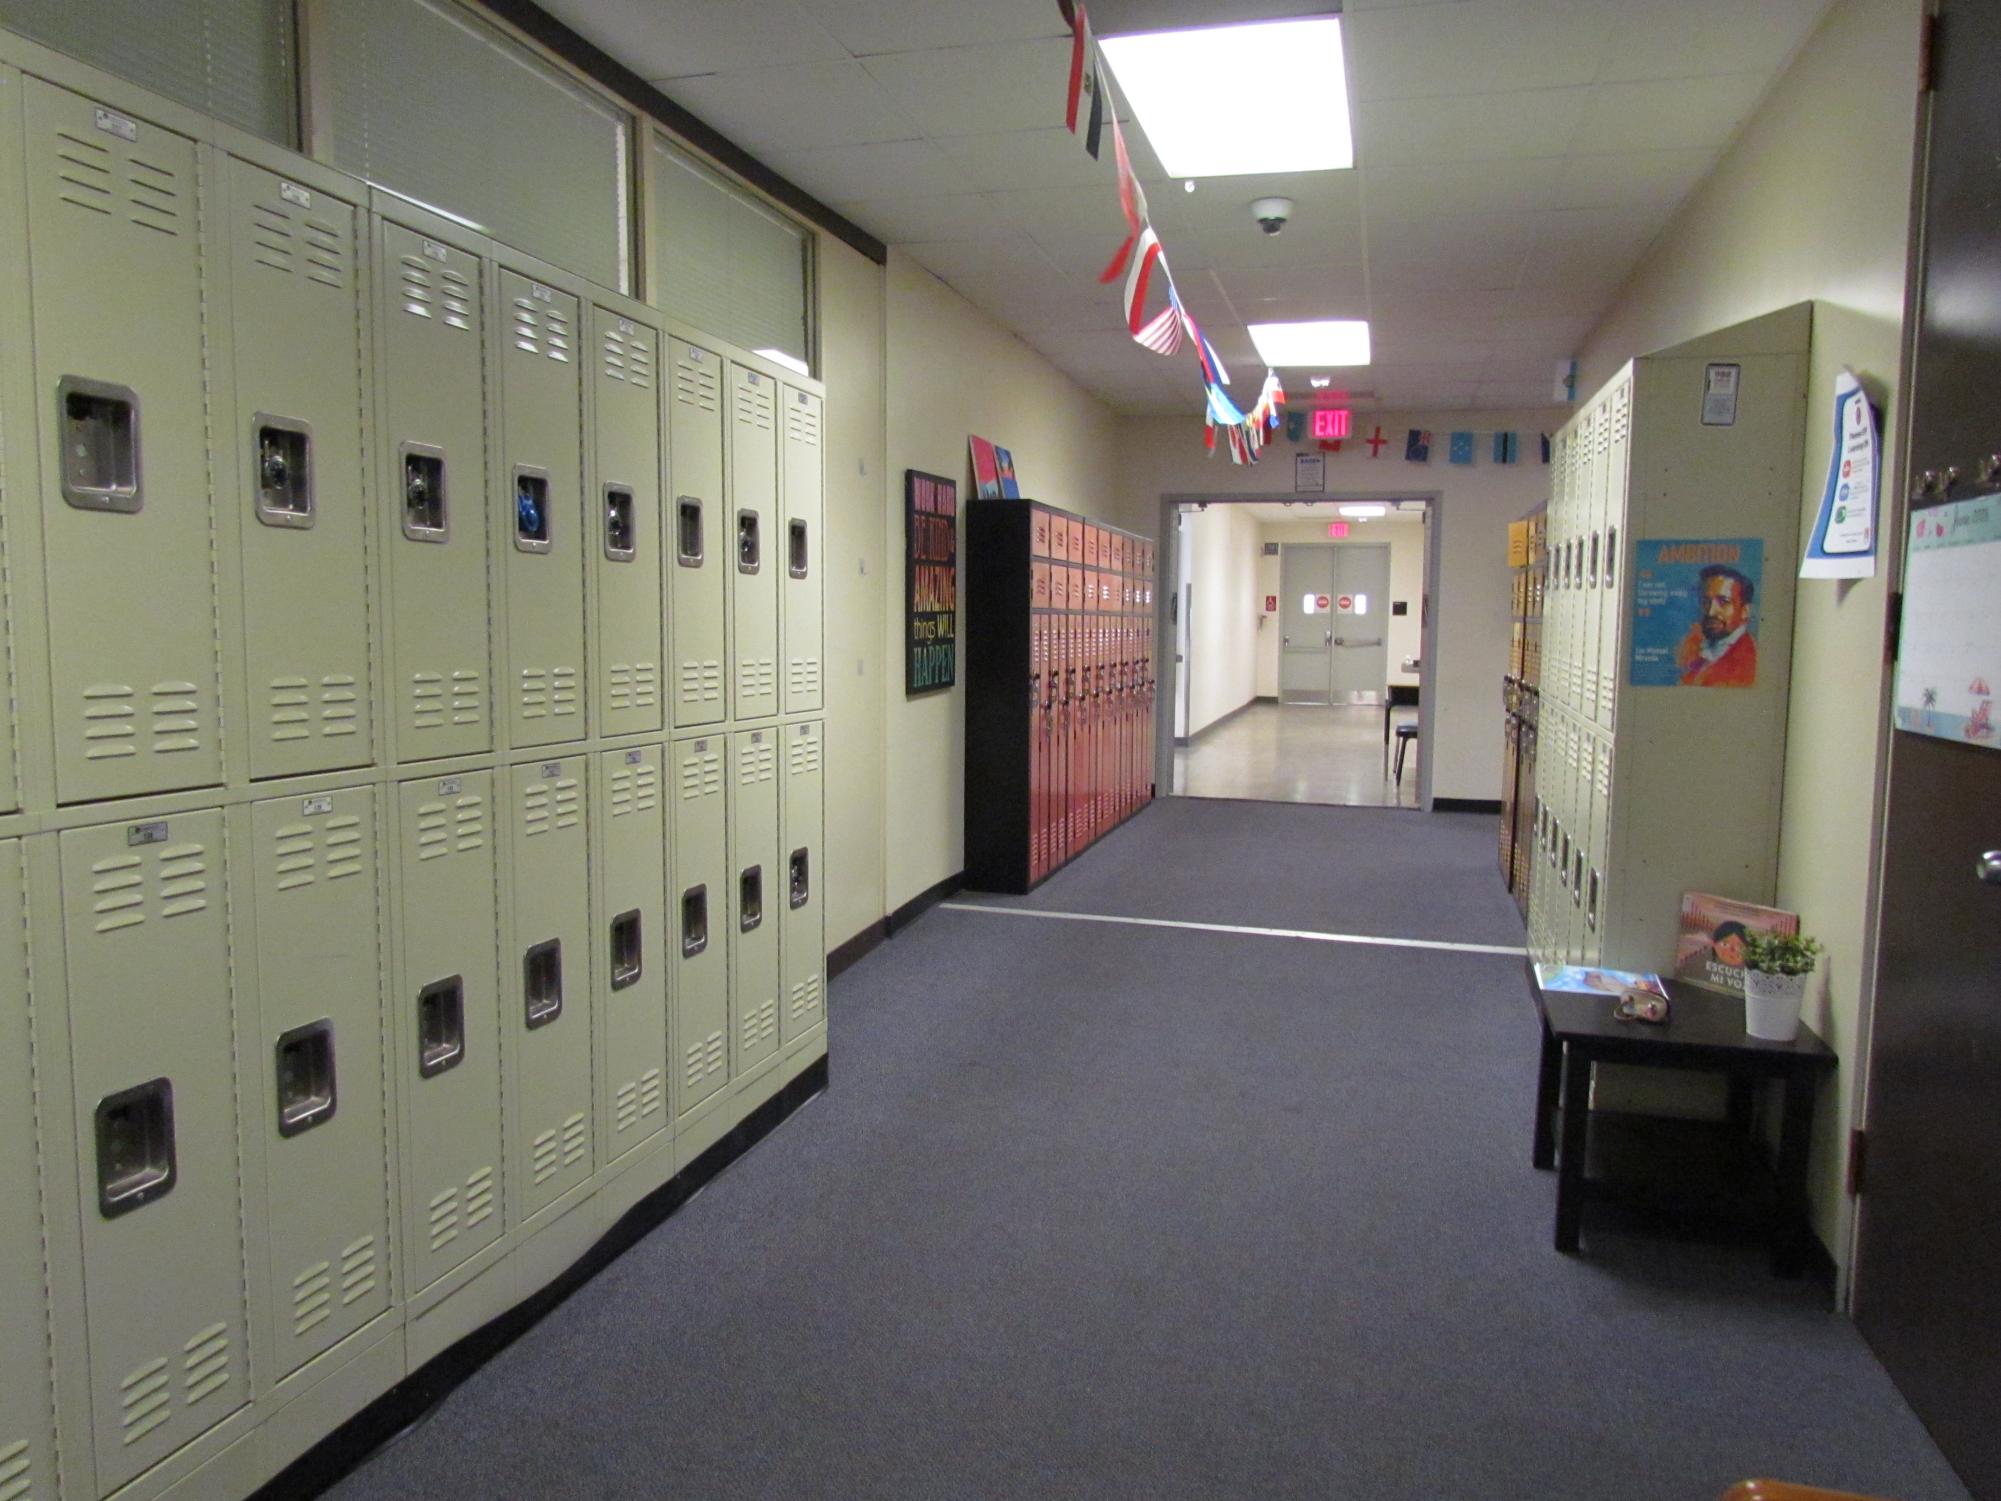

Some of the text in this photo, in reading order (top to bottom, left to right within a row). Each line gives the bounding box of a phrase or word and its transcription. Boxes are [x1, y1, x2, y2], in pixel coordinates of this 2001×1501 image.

[1315, 410, 1348, 436] EXIT
[1659, 544, 1739, 562] AMBITION
[913, 565, 955, 612] AMAZING
[913, 614, 954, 645] things WILL
[913, 643, 954, 688] HAPPEN
[1710, 973, 1745, 991] MI VO
